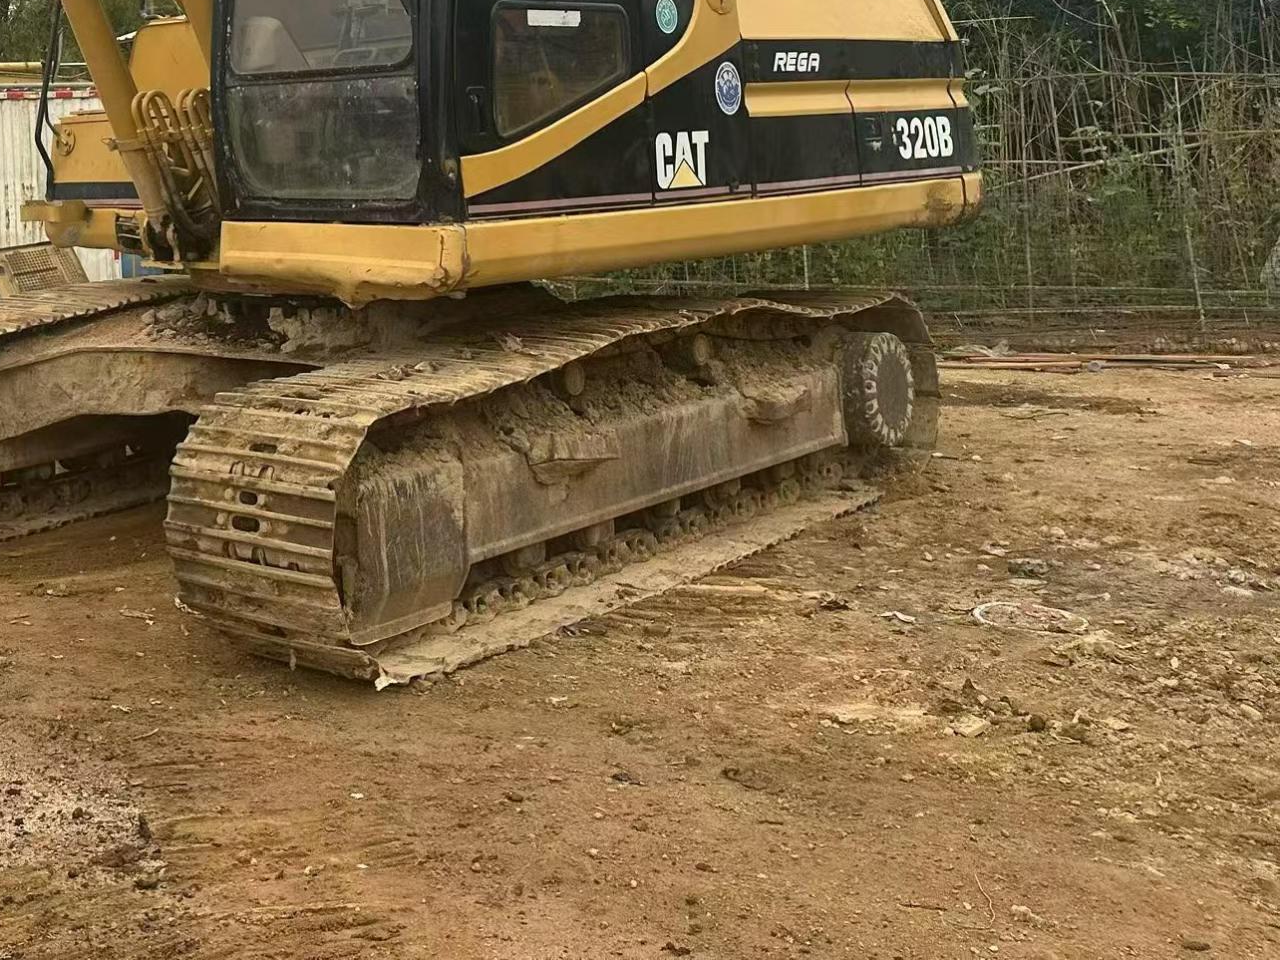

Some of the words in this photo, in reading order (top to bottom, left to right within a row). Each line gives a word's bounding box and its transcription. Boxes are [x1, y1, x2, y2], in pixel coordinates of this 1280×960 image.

[773, 51, 820, 72] REGA
[655, 130, 709, 189] CAT
[896, 116, 954, 160] 320B
